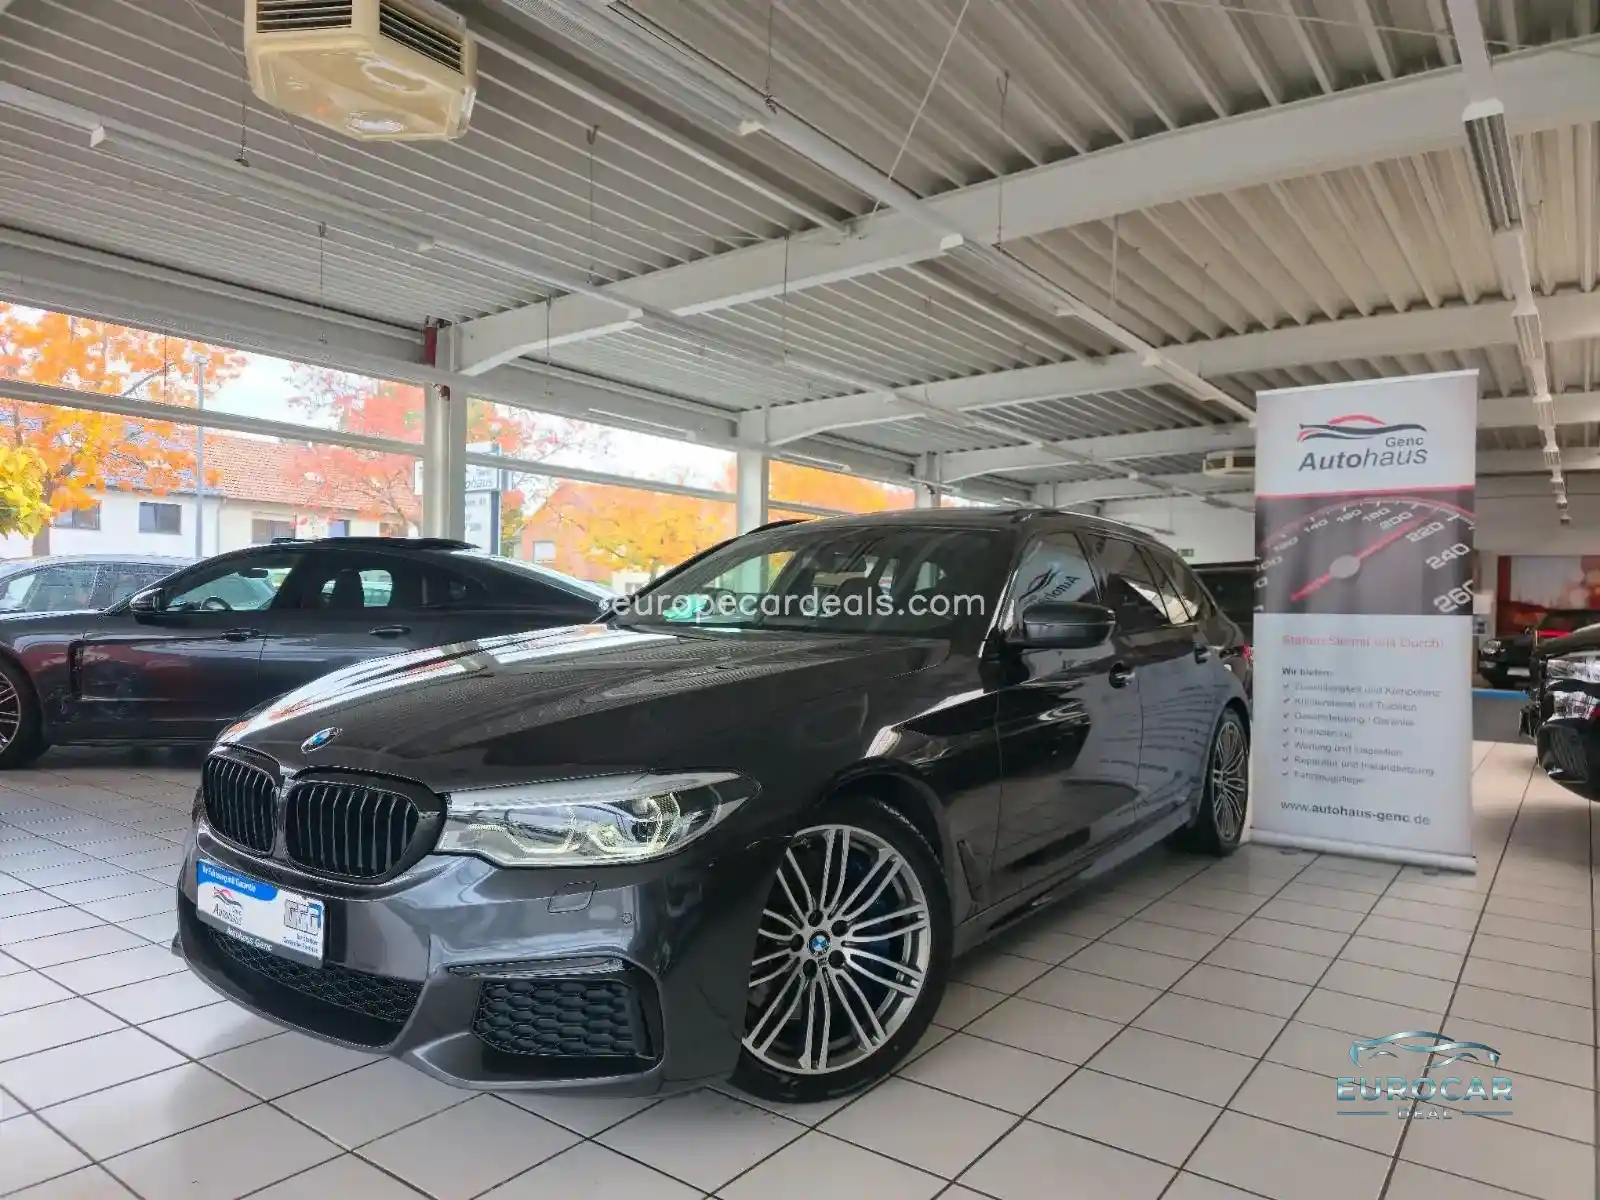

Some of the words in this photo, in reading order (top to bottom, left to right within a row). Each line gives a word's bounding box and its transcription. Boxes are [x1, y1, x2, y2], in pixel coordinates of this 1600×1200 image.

[1385, 436, 1424, 447] Genc
[1298, 448, 1428, 472] Autohaus
[465, 476, 493, 488] ohaus
[1425, 543, 1470, 570] 240
[1280, 801, 1431, 825] www.autohaus-genc.de
